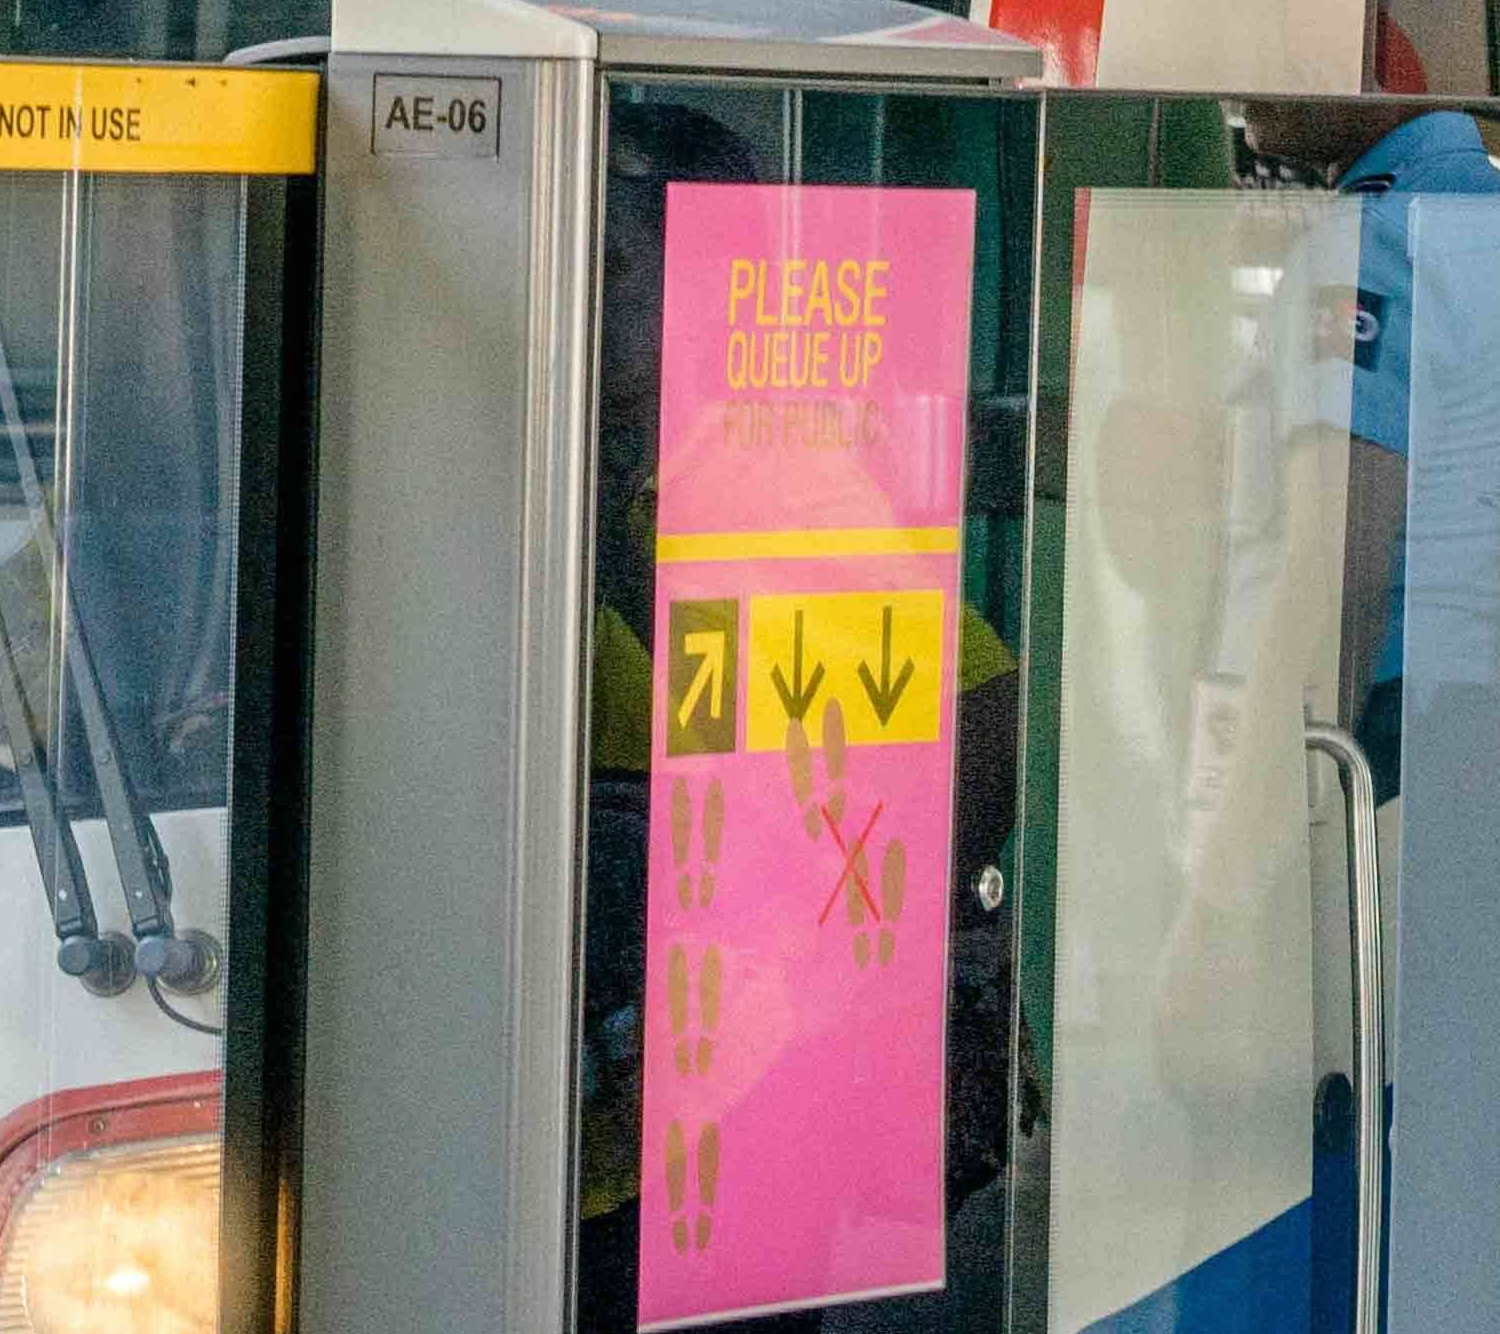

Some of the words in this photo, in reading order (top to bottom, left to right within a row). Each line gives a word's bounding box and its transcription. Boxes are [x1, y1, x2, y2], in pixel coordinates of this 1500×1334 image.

[58, 107, 82, 139] IN
[91, 108, 141, 142] USE
[384, 95, 487, 134] AE-06
[728, 258, 891, 328] PLEASE
[726, 330, 831, 391] QUEUE
[839, 331, 885, 389] UP
